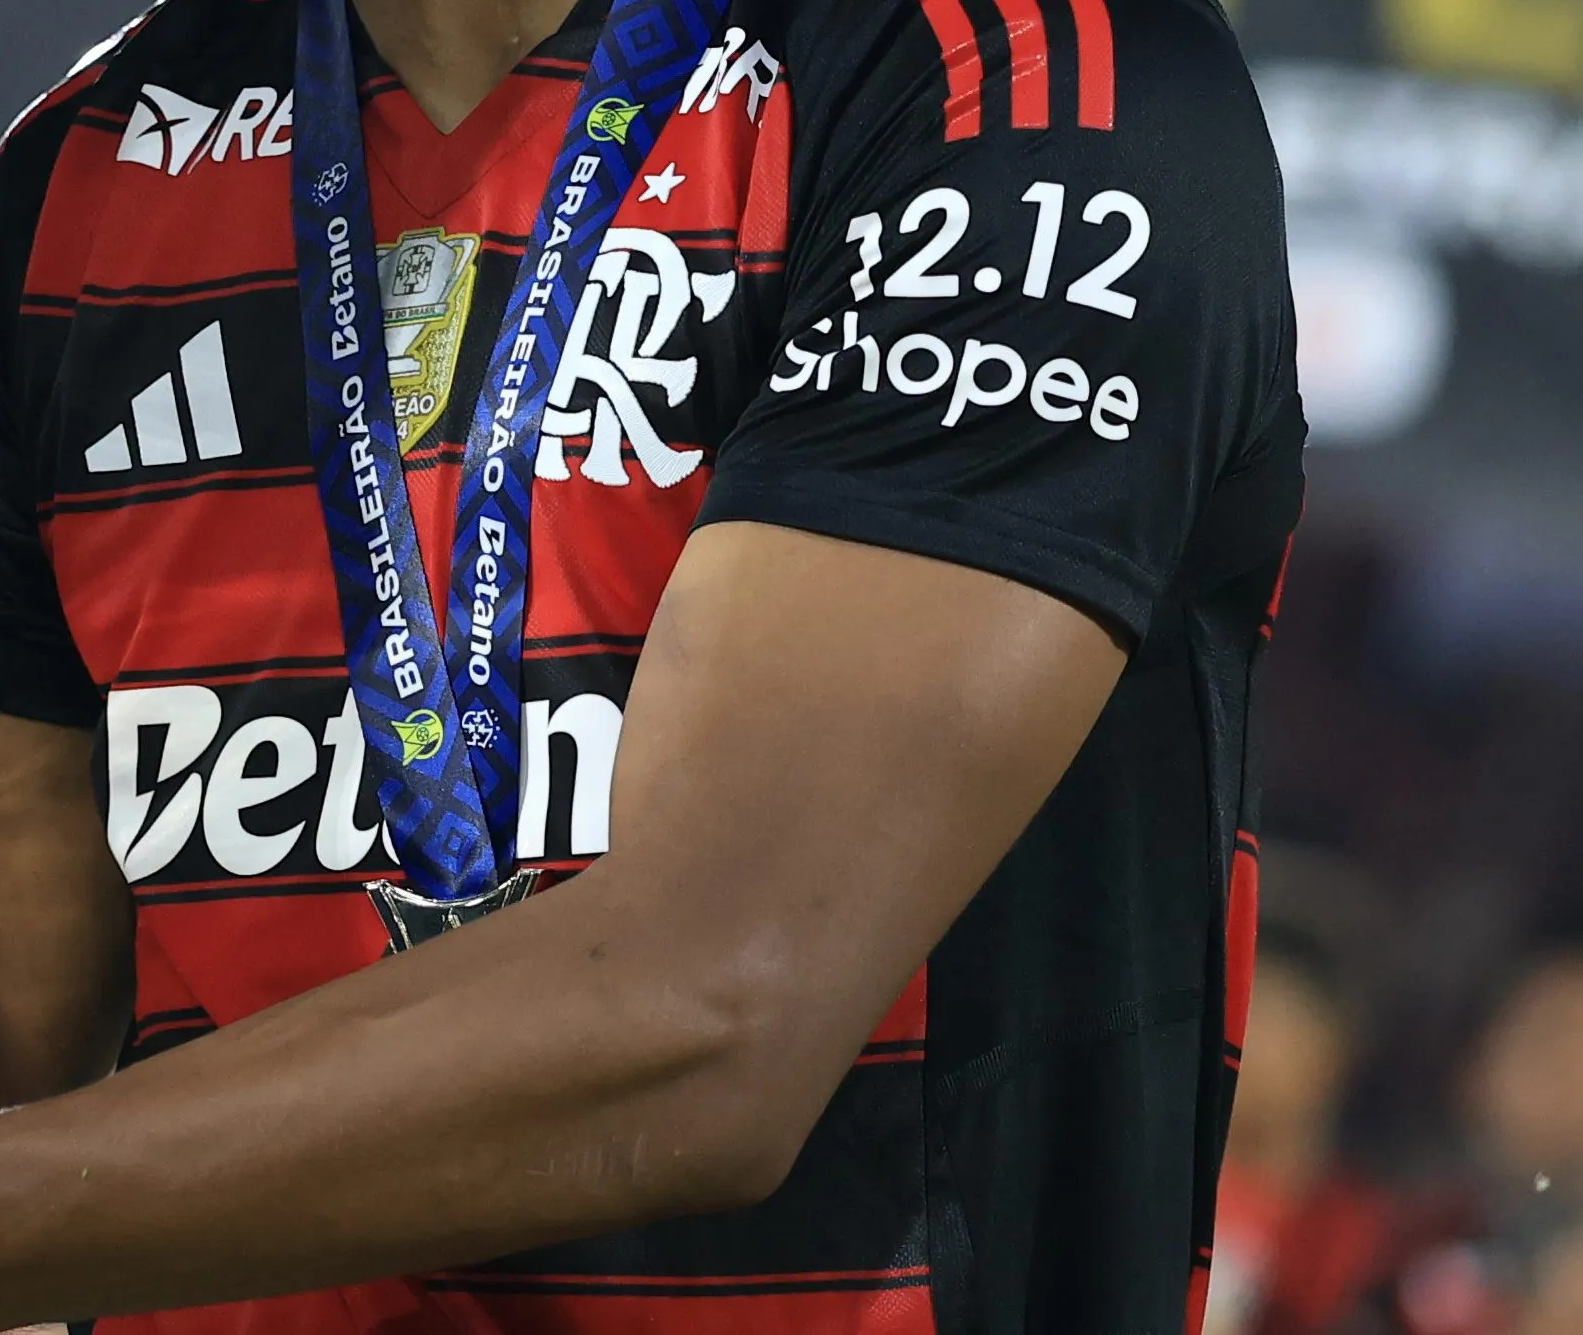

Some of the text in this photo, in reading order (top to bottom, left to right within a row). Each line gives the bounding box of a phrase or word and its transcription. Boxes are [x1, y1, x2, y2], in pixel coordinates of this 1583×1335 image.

[327, 215, 360, 360] Betano
[845, 181, 1151, 319] 12.12
[468, 154, 600, 687] BRASILEIRÃO Betano
[769, 312, 1140, 441] Shopee
[338, 376, 425, 700] BRASILEIRÃO
[107, 684, 626, 884] Betn
